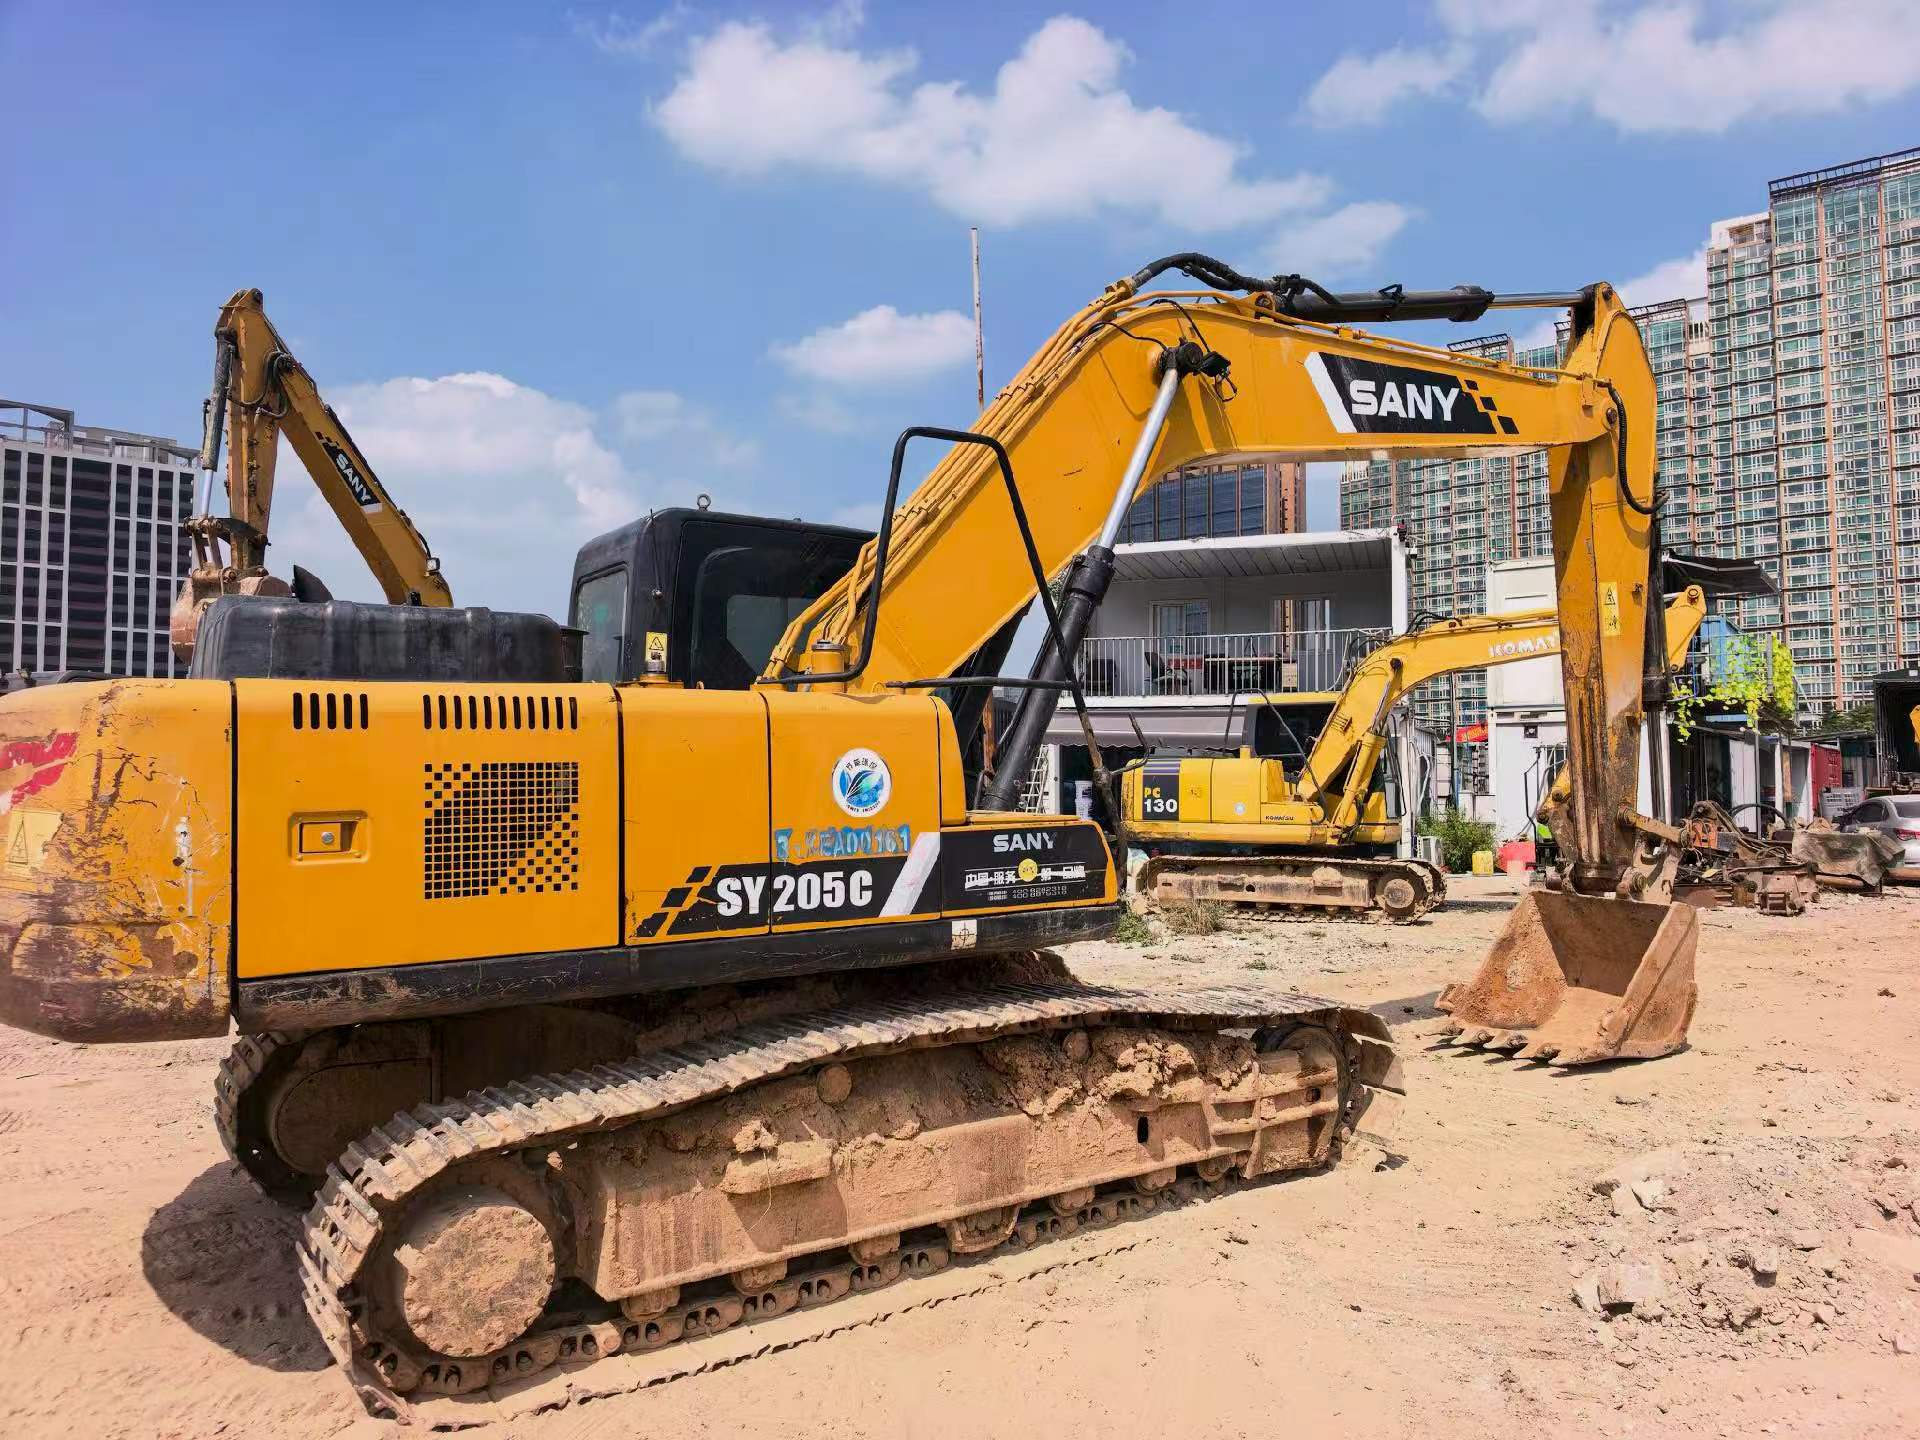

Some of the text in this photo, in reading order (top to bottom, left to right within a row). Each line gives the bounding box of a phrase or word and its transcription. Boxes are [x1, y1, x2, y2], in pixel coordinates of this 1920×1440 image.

[1349, 378, 1460, 422] SANY
[335, 453, 372, 502] SANY
[1143, 787, 1161, 798] PC
[1143, 798, 1178, 813] 130
[992, 831, 1058, 853] SANY
[716, 869, 873, 917] SY 205C
